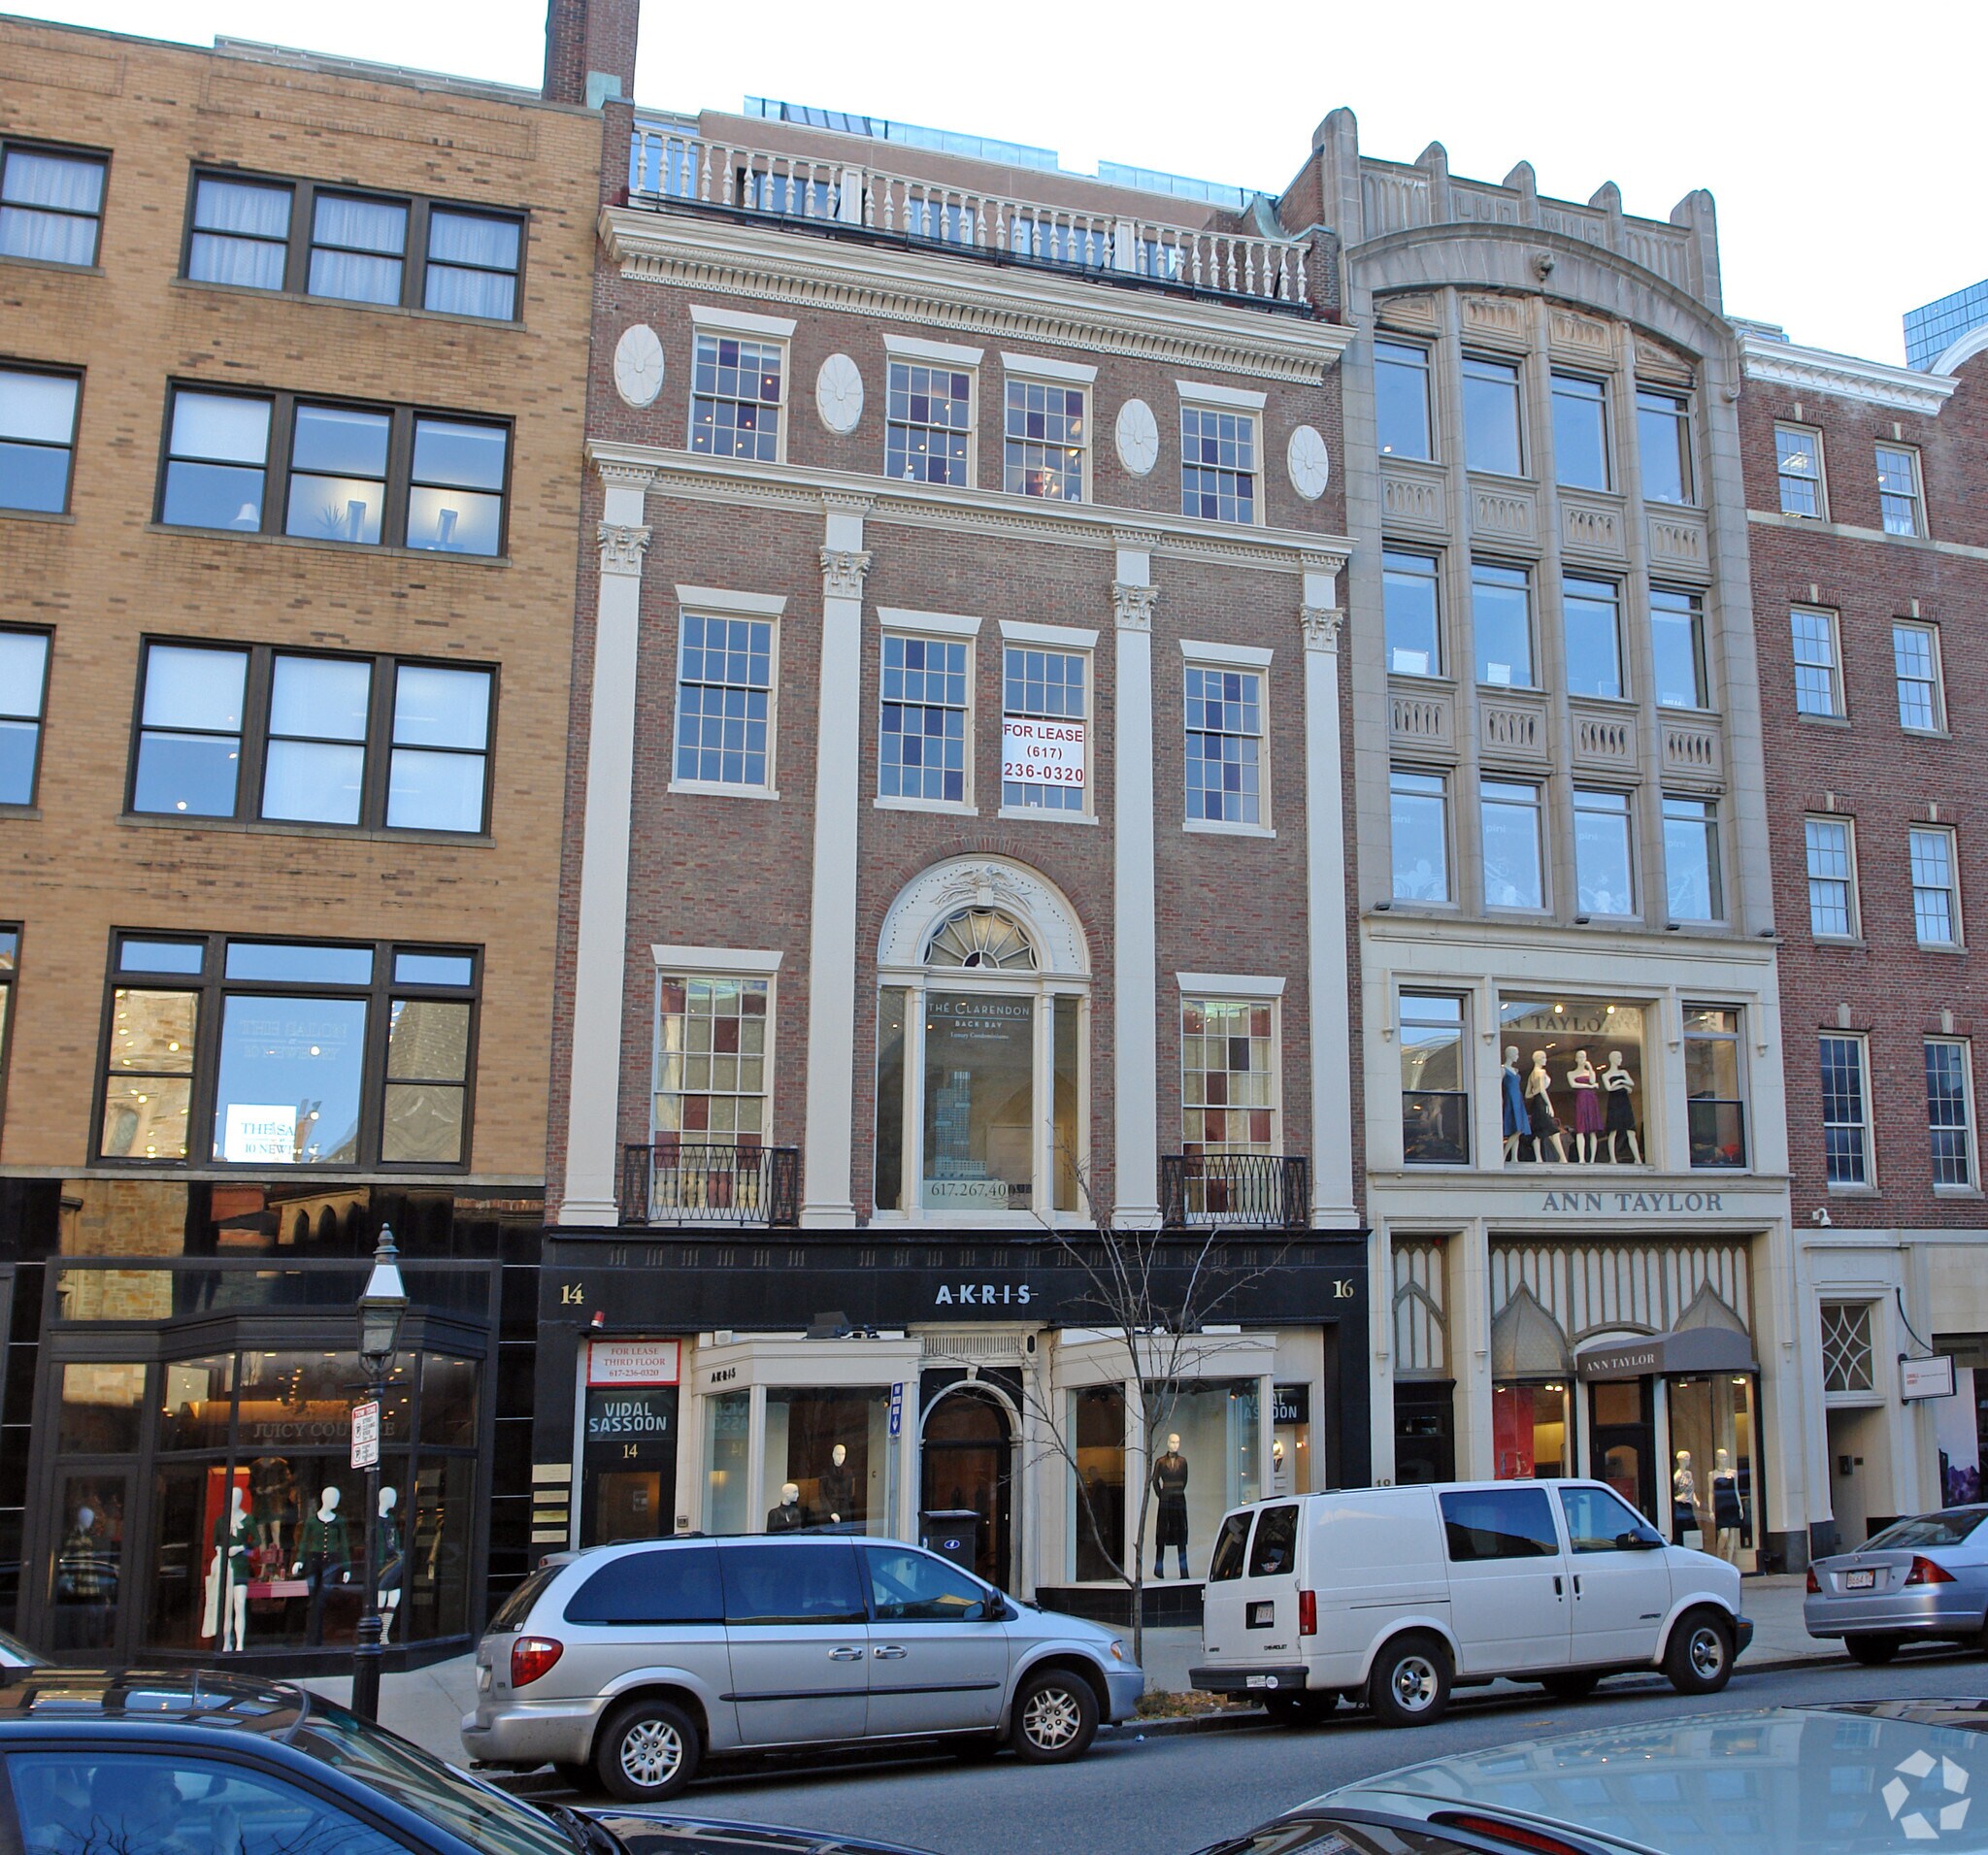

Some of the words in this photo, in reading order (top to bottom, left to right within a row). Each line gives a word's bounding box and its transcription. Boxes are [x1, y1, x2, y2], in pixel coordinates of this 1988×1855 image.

[1003, 723, 1033, 738] FOR
[1037, 726, 1083, 743] LEASE
[1026, 745, 1063, 760] (617)
[1004, 762, 1083, 782] 236-0320
[927, 1003, 950, 1013] THE
[955, 1003, 1030, 1016] CLARENDON
[241, 1122, 273, 1135] THE
[277, 1124, 294, 1136] SA
[1541, 1193, 1602, 1211] ANN
[1614, 1193, 1723, 1212] TAYLOR
[560, 1282, 584, 1305] 14
[935, 1284, 1032, 1305] AKRIS
[1333, 1278, 1354, 1299] 16
[612, 1347, 629, 1356] FOR
[631, 1346, 659, 1355] LEASE
[1586, 1360, 1608, 1372] ANN
[1611, 1353, 1654, 1369] TAYLOR
[609, 1369, 659, 1377] 617-236-0320
[605, 1402, 652, 1417] VIDAL
[253, 1422, 304, 1438] JUICY
[588, 1416, 667, 1433] SASSOON
[622, 1443, 638, 1459] 14
